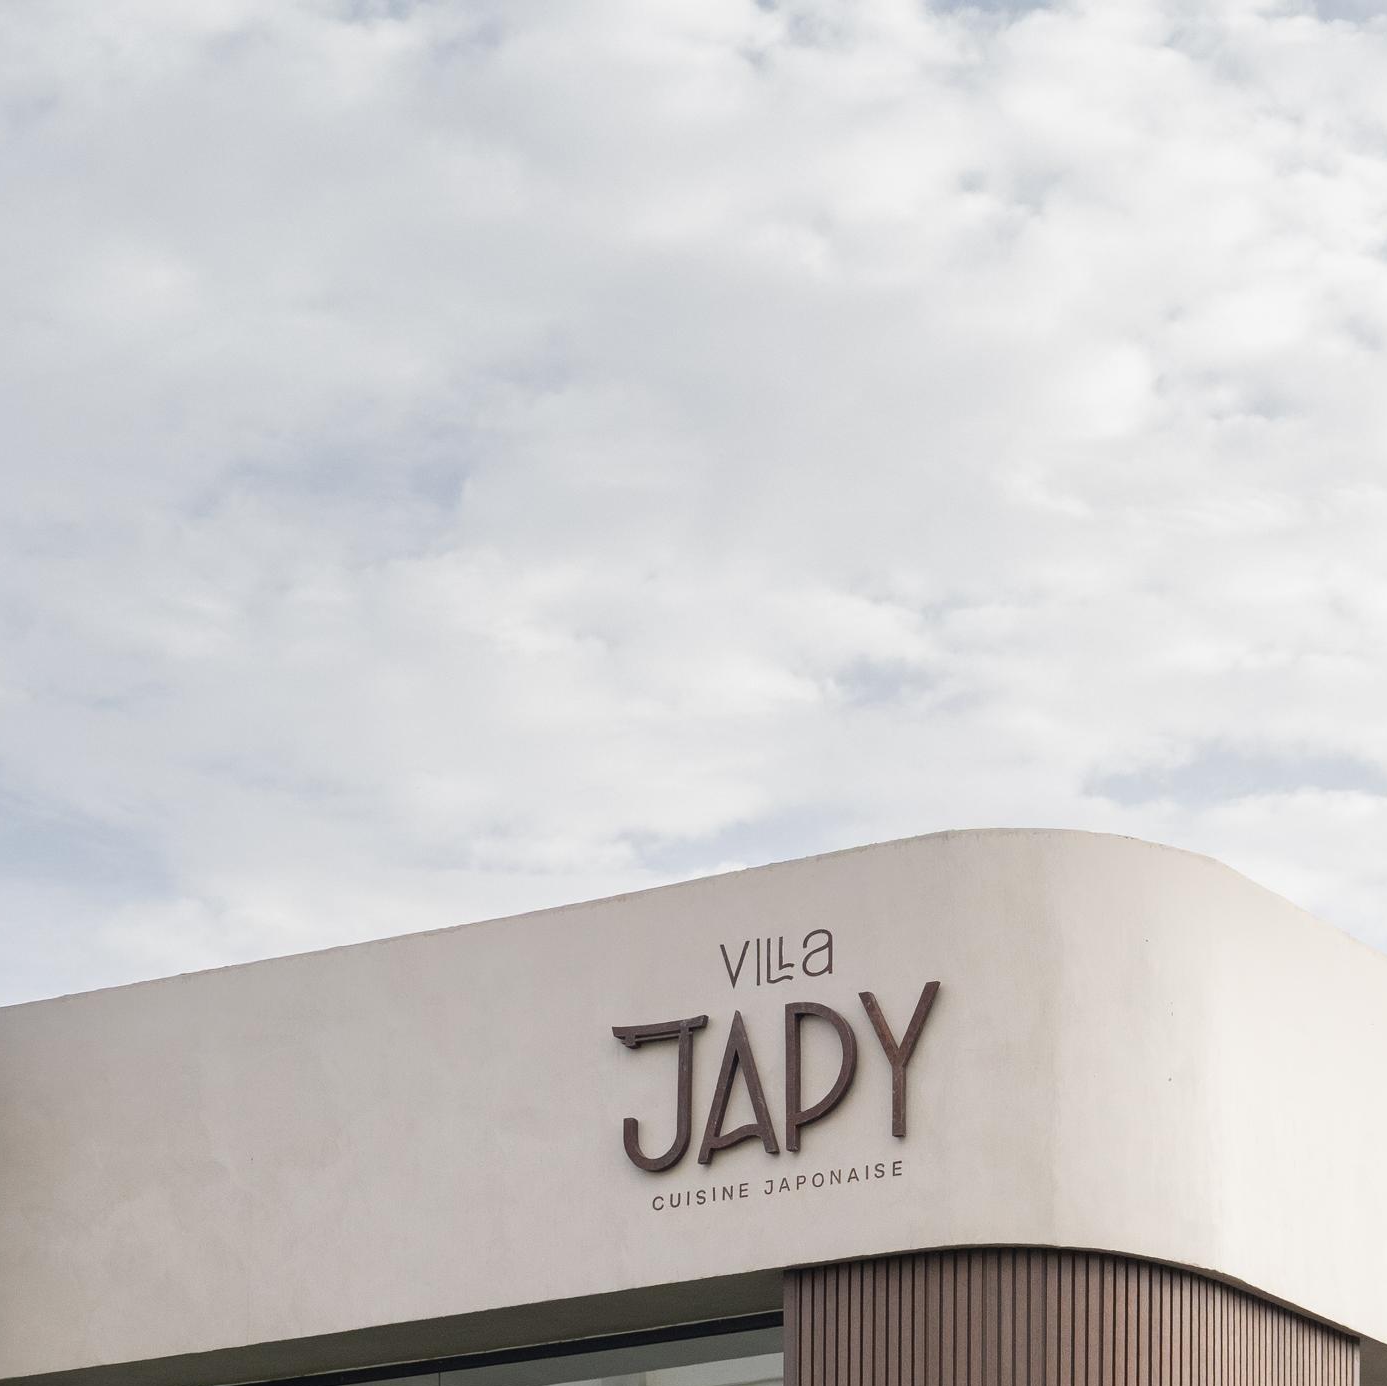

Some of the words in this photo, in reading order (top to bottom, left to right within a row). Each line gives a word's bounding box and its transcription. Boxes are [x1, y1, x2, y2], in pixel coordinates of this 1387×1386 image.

[611, 980, 941, 1173] JAPY
[651, 1182, 750, 1212] CUISINE
[763, 1160, 904, 1195] JAPONAISE
